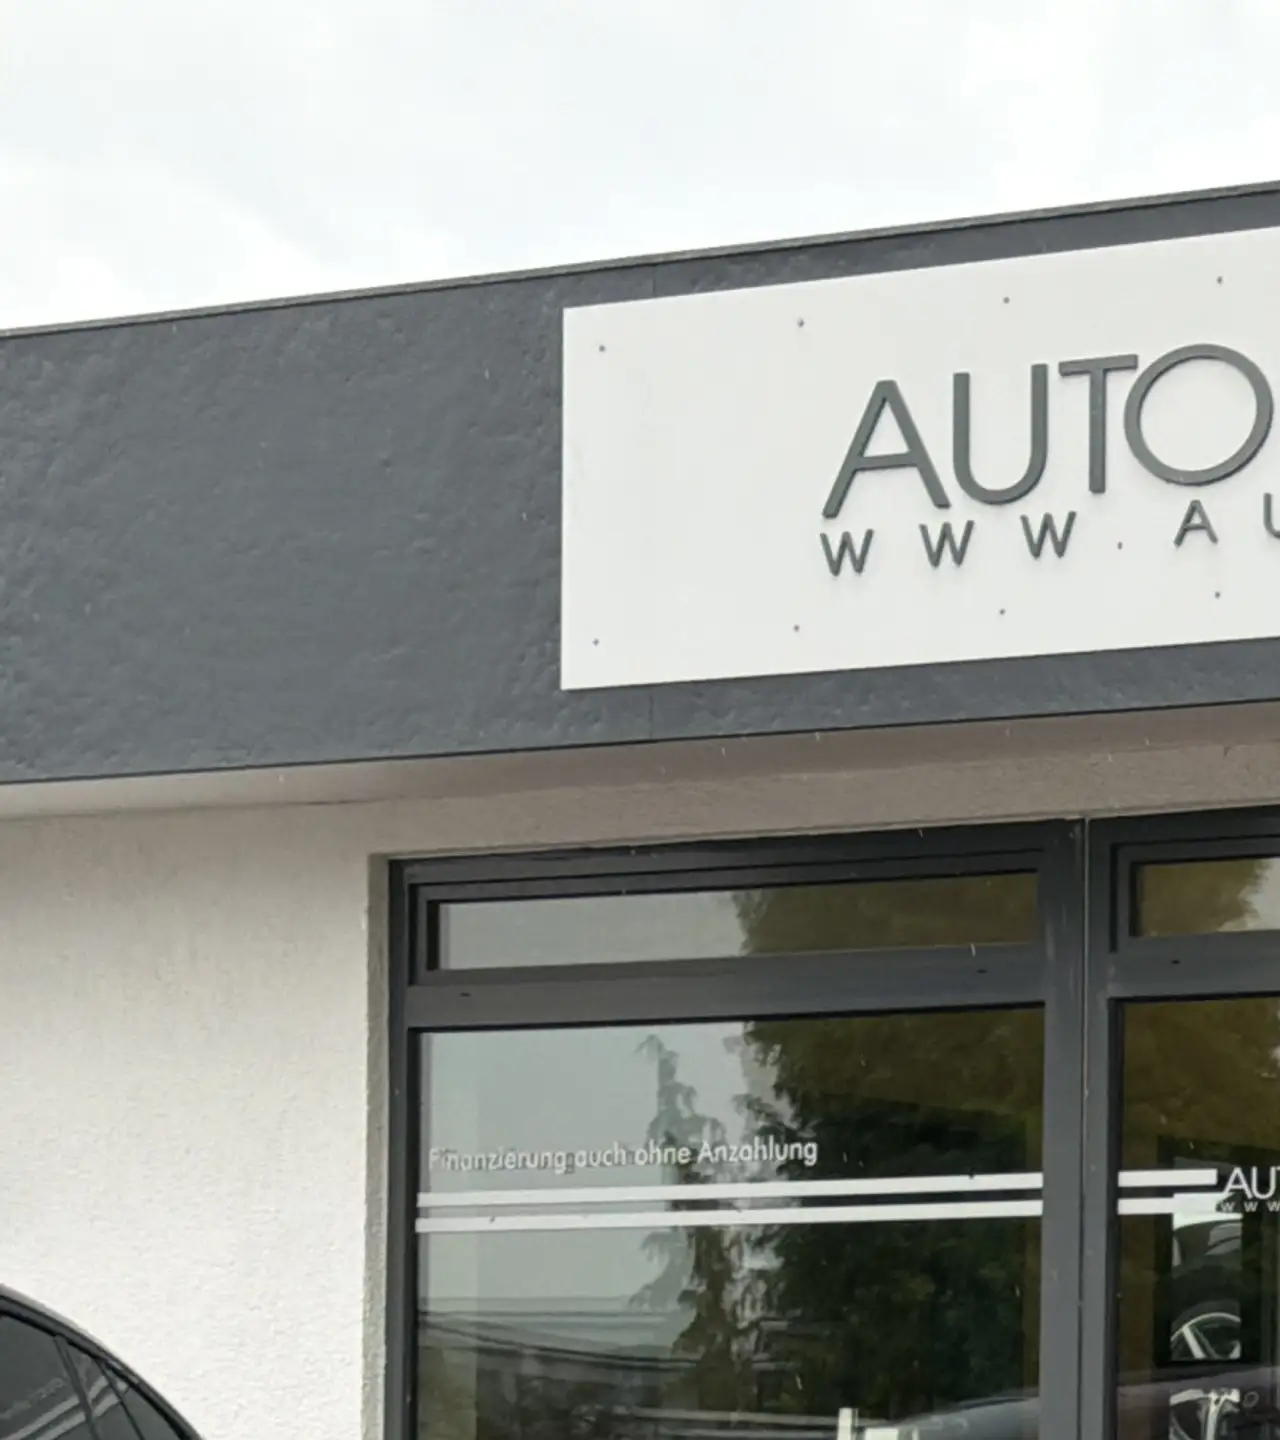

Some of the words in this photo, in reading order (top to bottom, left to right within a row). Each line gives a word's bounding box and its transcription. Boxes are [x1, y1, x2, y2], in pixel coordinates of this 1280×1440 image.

[822, 342, 1275, 520] AUTO
[428, 1146, 567, 1175] Finanzierung
[574, 1140, 626, 1168] auch
[637, 1137, 692, 1166] ohne
[696, 1135, 818, 1167] Anzahlung
